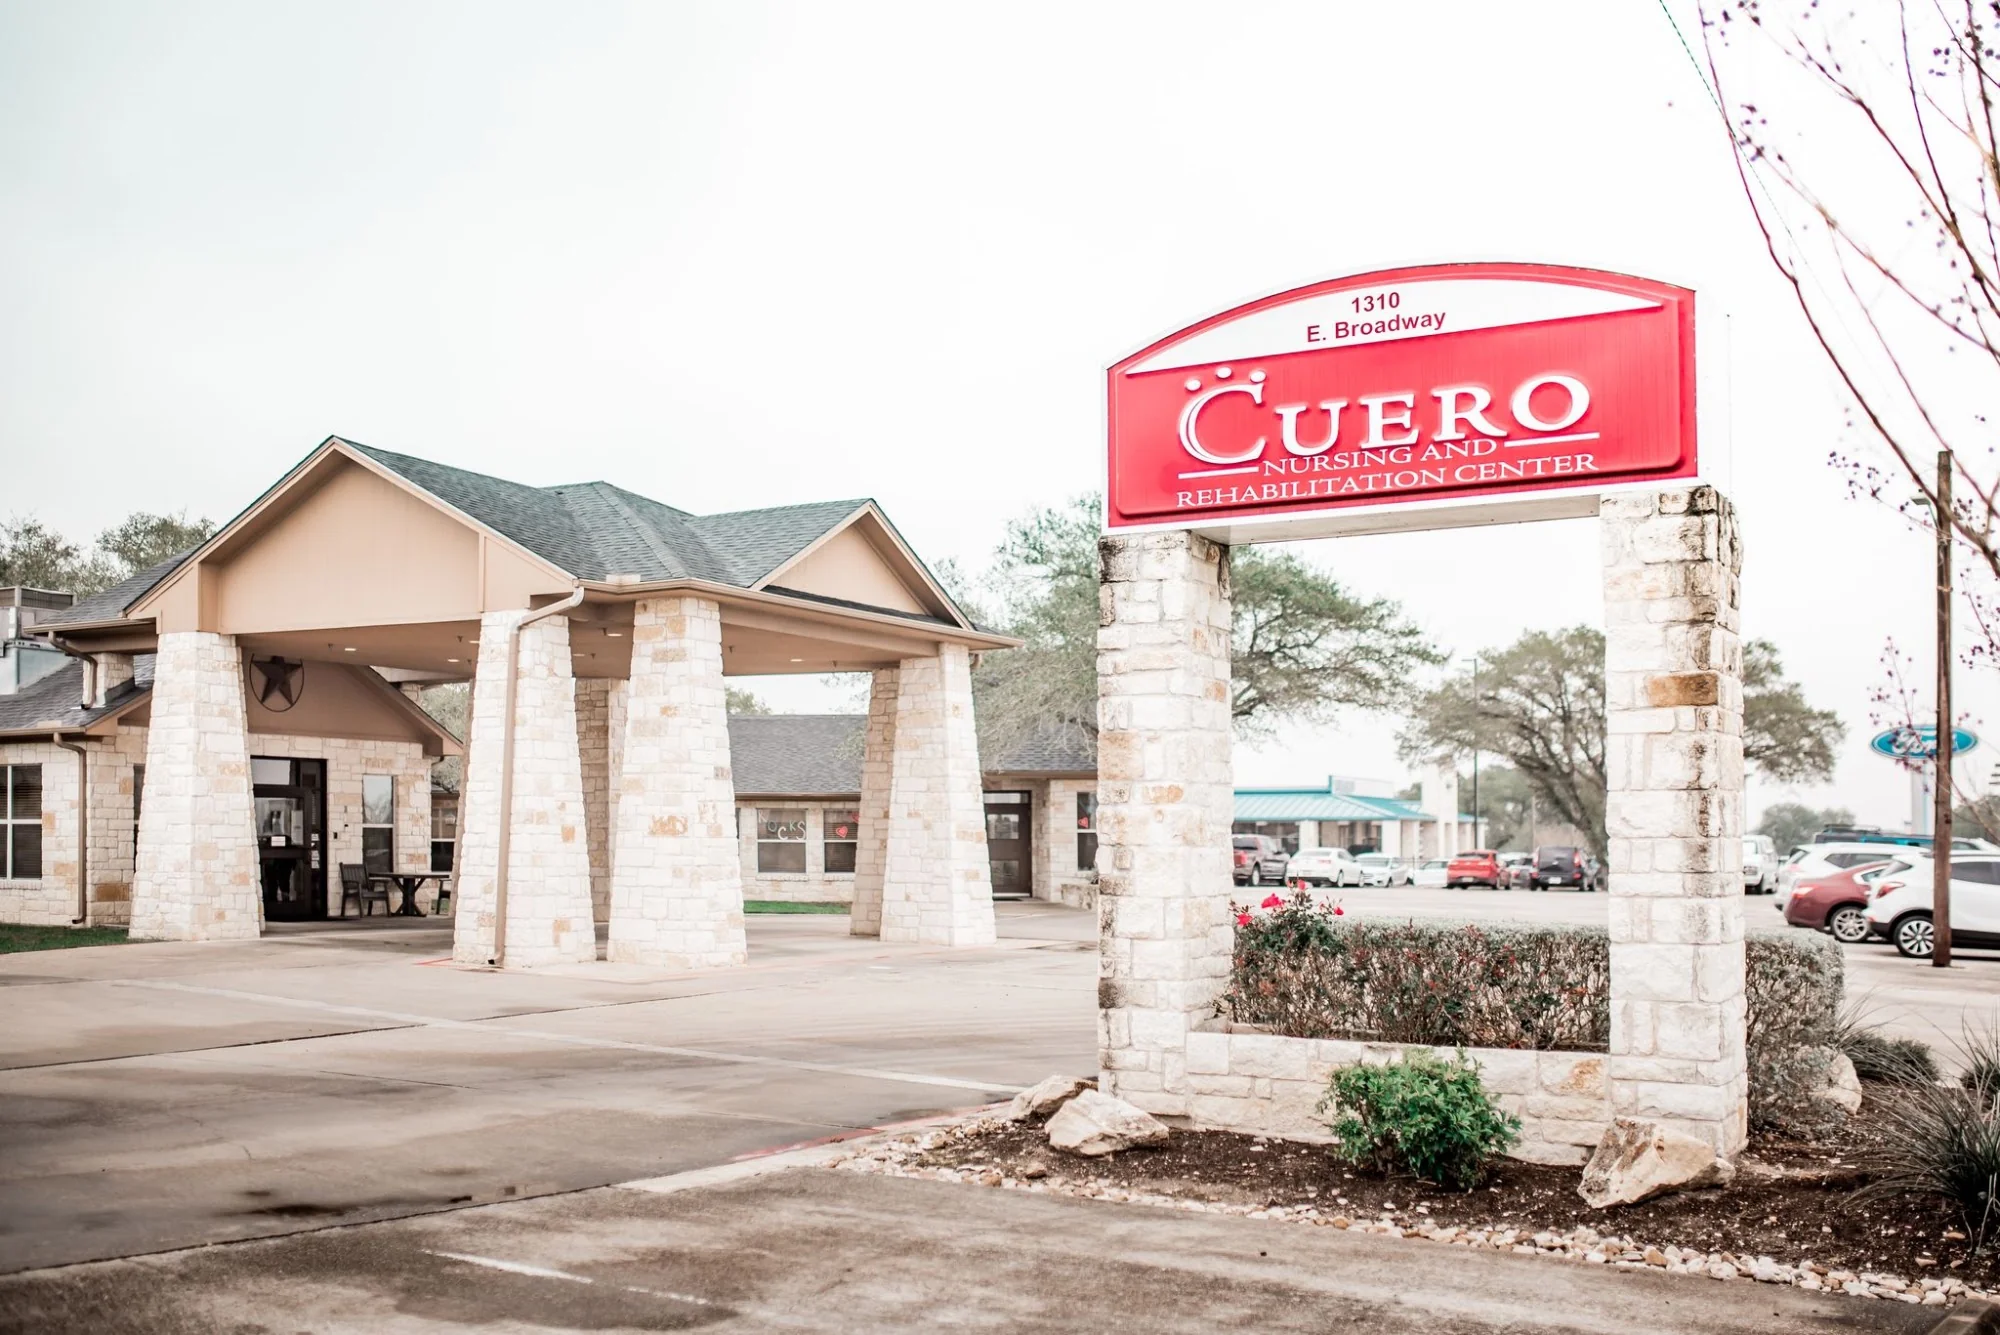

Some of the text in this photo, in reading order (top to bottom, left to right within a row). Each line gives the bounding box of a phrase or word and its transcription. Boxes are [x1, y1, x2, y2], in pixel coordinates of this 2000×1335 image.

[1351, 291, 1400, 313] 1310
[1307, 312, 1446, 343] E. Broadway
[1179, 375, 1590, 465] CUERO
[1263, 438, 1498, 477] NURSING AND
[1176, 453, 1600, 508] REHABILITATION CENTER
